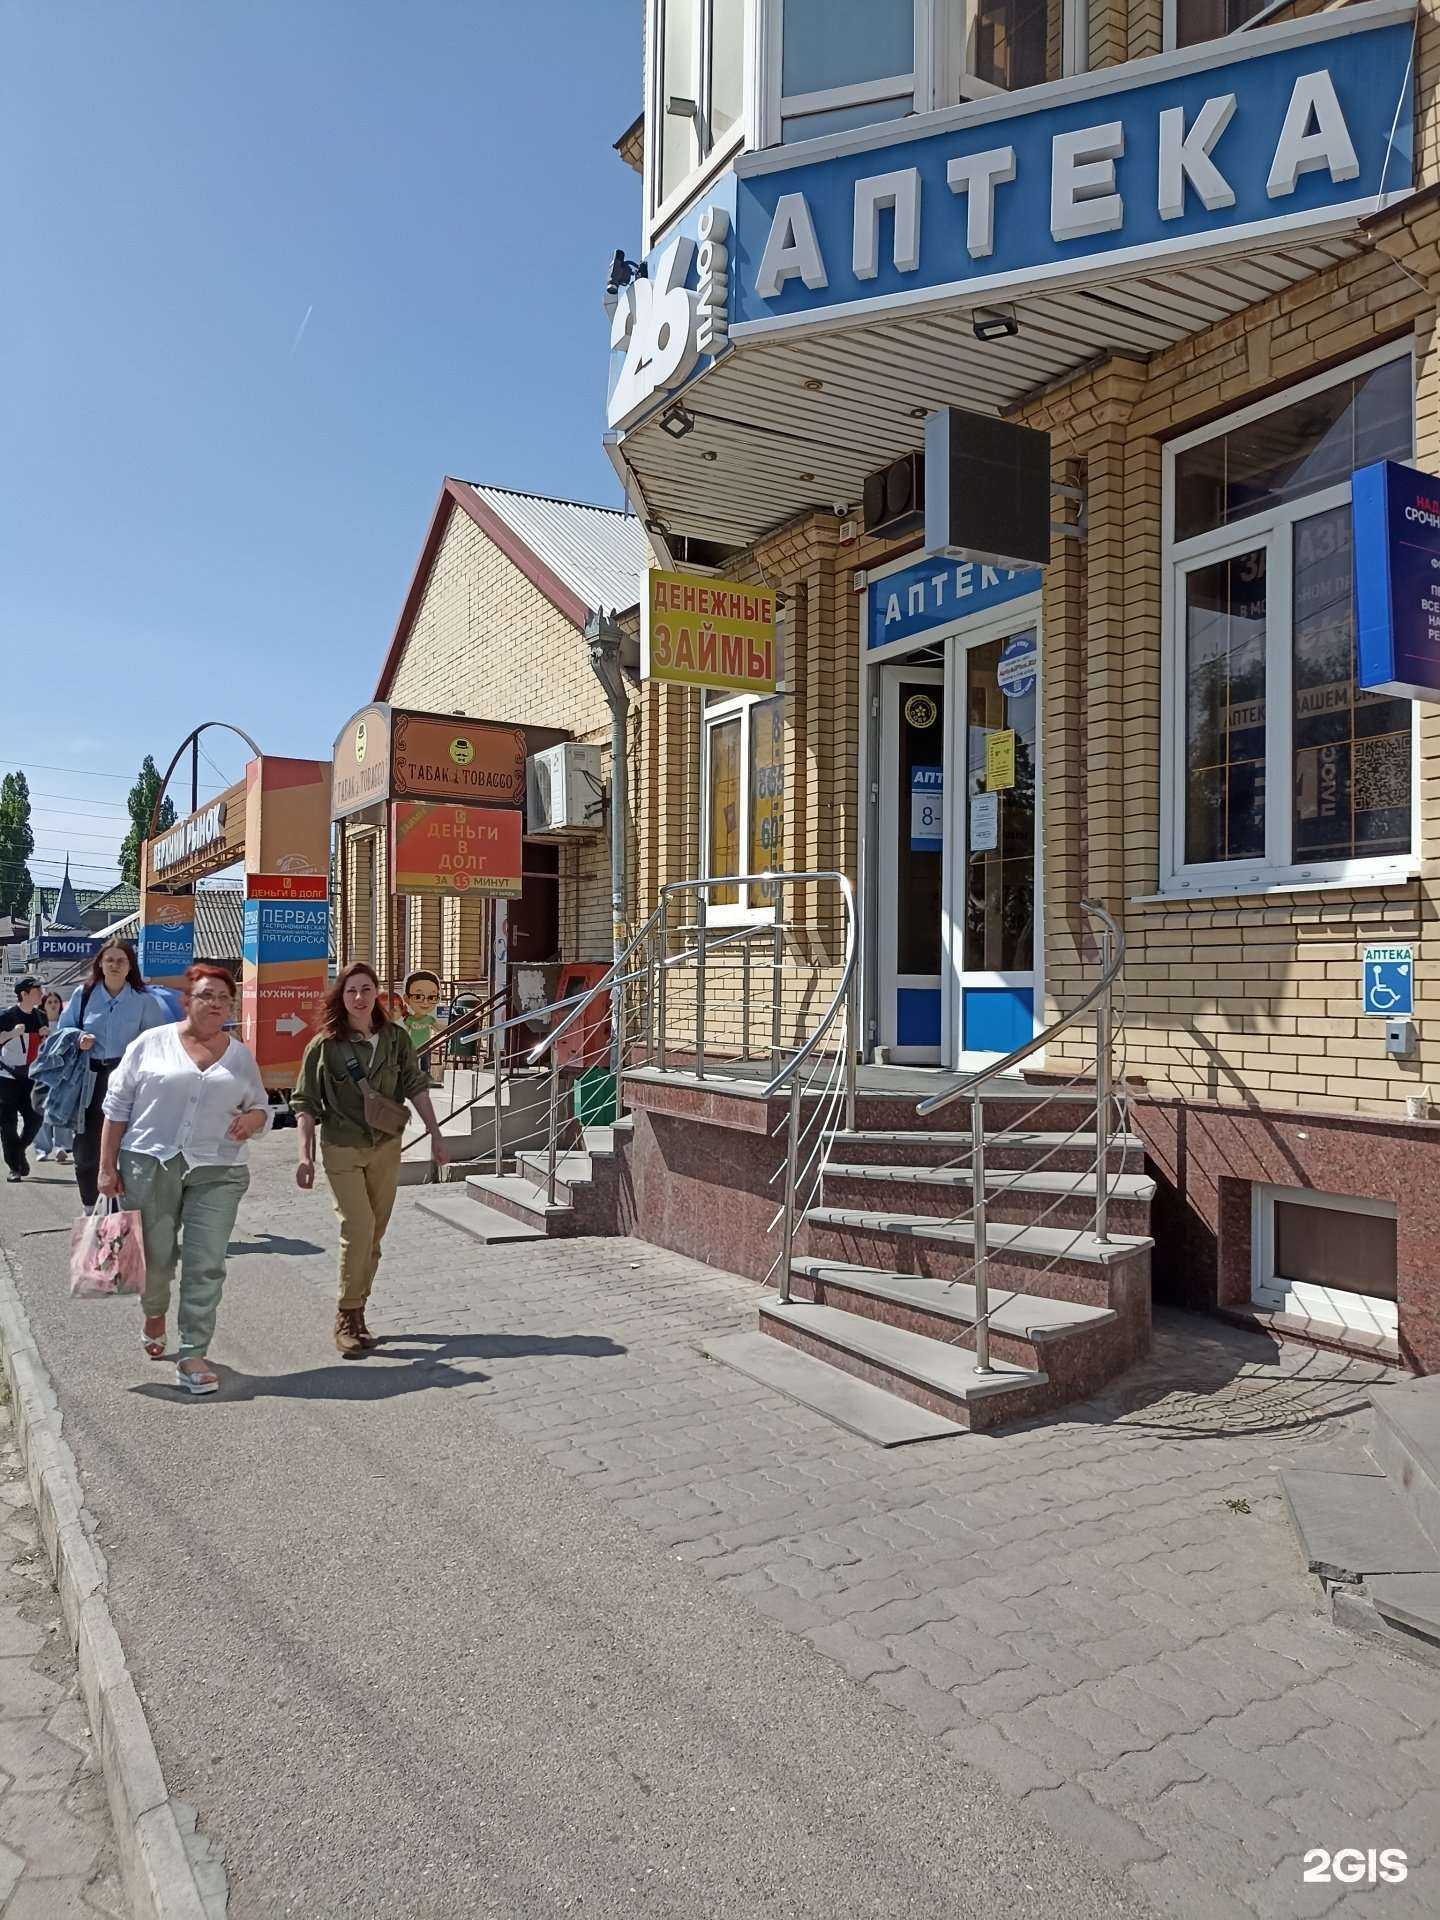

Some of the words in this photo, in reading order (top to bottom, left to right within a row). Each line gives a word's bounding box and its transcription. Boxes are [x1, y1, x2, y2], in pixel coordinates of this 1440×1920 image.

[755, 69, 1360, 298] АПТЕКА
[608, 236, 696, 430] 26
[697, 205, 726, 354] ПЛЮС
[1416, 496, 1440, 516] НАД
[1405, 506, 1440, 529] СРОЧН
[655, 581, 771, 624] ДЕНЕЖНЫЕ
[885, 563, 1015, 626] АПТЕК
[655, 622, 772, 680] ЗАЙМЫ
[1224, 705, 1266, 726] АПТЕК
[408, 763, 449, 783] ТАБАК
[462, 769, 513, 790] TOBACCO
[913, 771, 943, 783] АПТ
[922, 806, 941, 825] 8-
[427, 823, 499, 841] ДЕНЬГИ
[458, 841, 468, 854] В
[439, 855, 487, 870] ДОЛГ
[434, 875, 447, 885] ЗА
[455, 876, 468, 888] 15
[473, 878, 510, 888] МИНУТ
[251, 889, 288, 898] ДЕНЬГИ
[290, 889, 297, 897] В
[299, 889, 324, 898] ДОЛГ
[262, 909, 327, 925] ПЕРВАЯ
[42, 941, 92, 953] РЕМОНТ
[146, 941, 192, 952] ПЕРВАЯ
[262, 934, 326, 944] ПЯТИГОРСКА
[1366, 949, 1411, 960] АПТЕКА
[259, 989, 295, 999] КУХНИ
